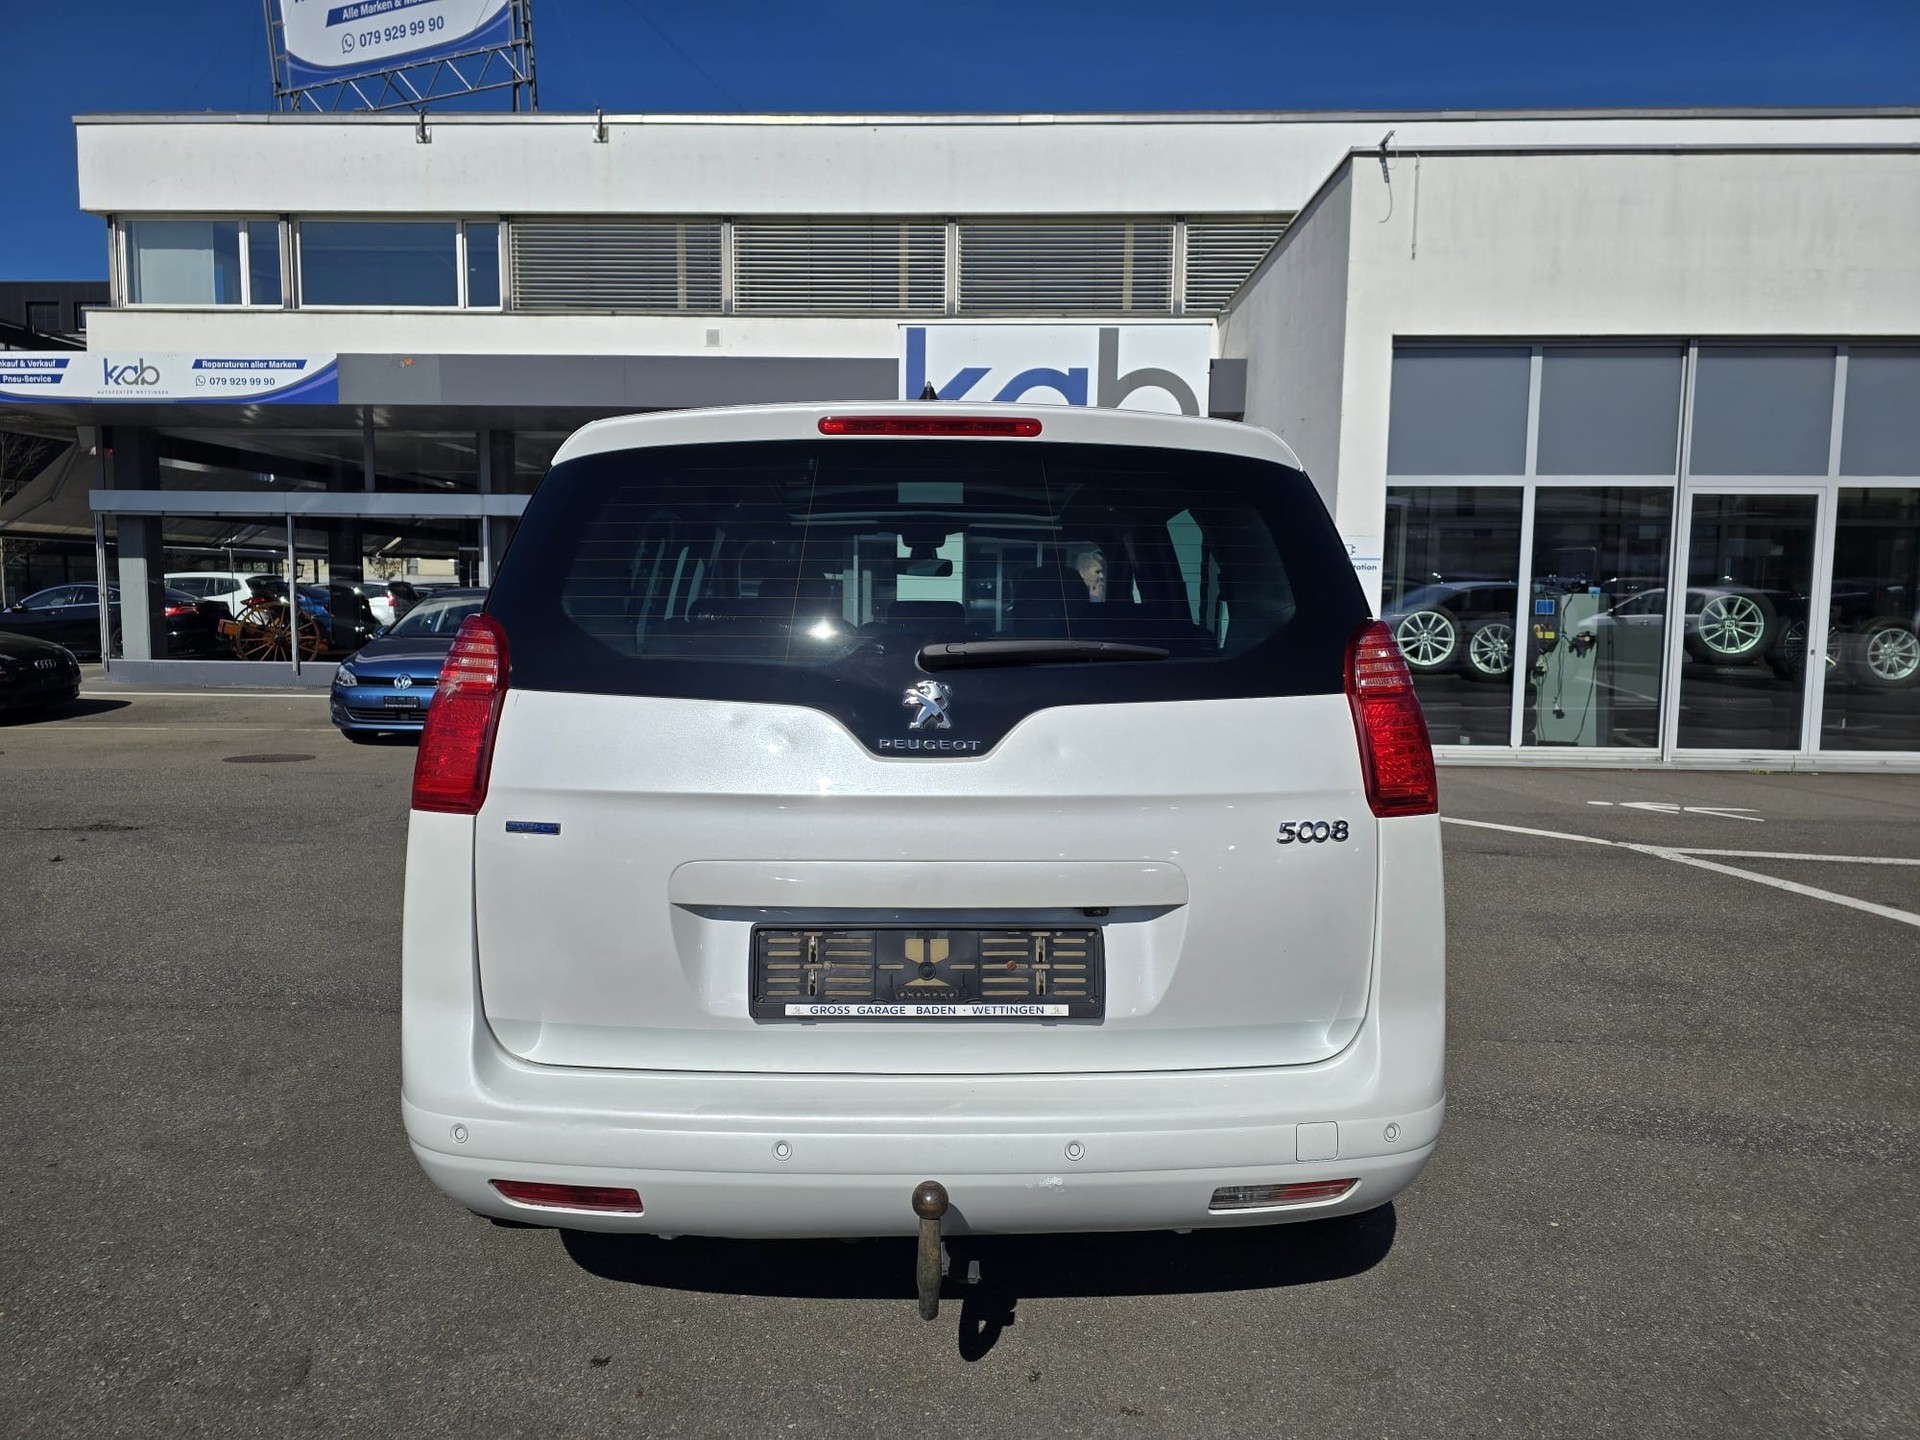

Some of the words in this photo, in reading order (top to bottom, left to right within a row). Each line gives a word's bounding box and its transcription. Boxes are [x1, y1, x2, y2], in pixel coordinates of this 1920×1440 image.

[342, 7, 359, 20] Alle
[360, 0, 393, 16] Marken
[360, 30, 381, 47] 079
[384, 24, 406, 42] 929
[410, 20, 425, 36] 99
[428, 16, 444, 31] 90
[103, 358, 160, 385] kab
[202, 361, 249, 369] Reparaturen
[3, 375, 52, 383] Pneu-Service
[879, 739, 981, 750] PEUGEOT
[1276, 820, 1349, 844] 5008
[809, 1006, 850, 1014] GROSS
[857, 1006, 906, 1014] GARAGE
[916, 1006, 956, 1014] BADEN
[972, 1006, 1045, 1015] WETTINGEN
